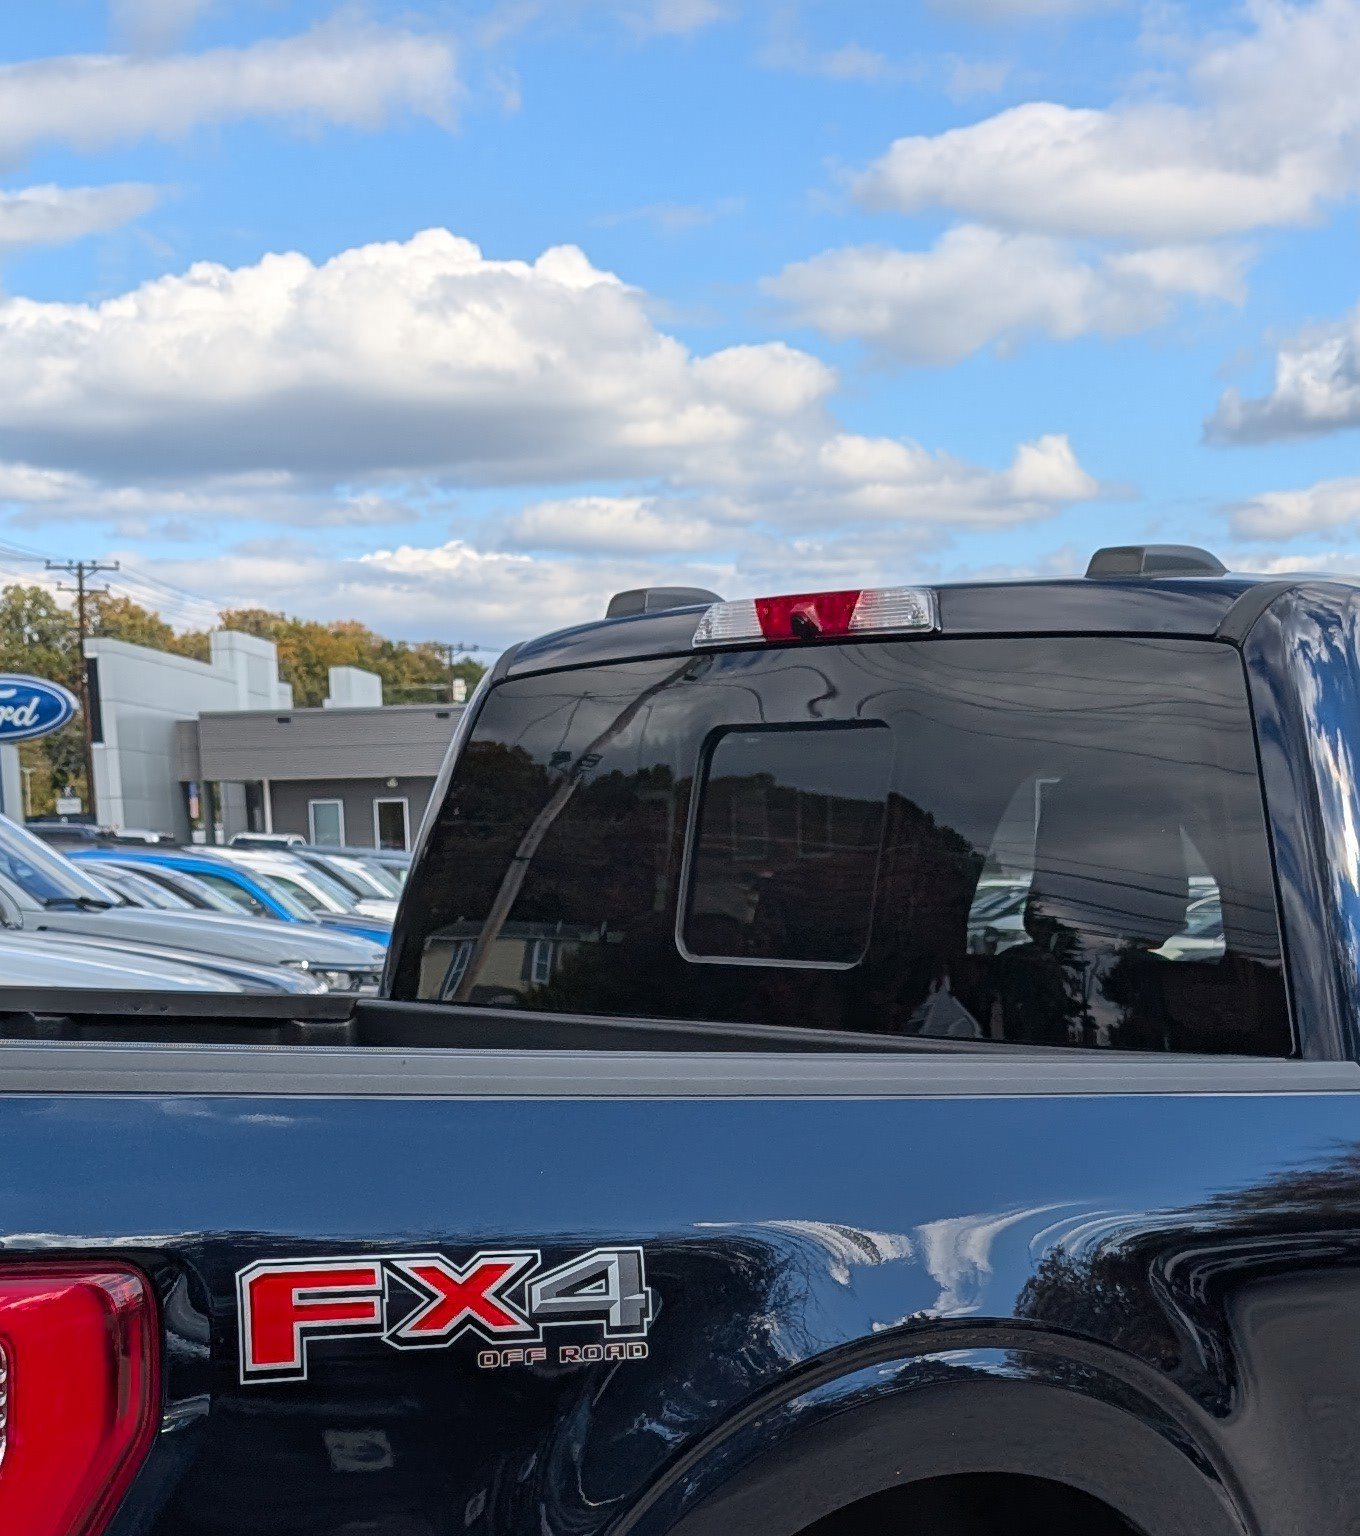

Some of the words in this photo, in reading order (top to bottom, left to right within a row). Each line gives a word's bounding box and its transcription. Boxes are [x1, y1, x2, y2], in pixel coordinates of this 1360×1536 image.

[235, 1246, 653, 1385] FX4
[476, 1346, 547, 1369] OFF
[558, 1341, 649, 1364] ROAD
